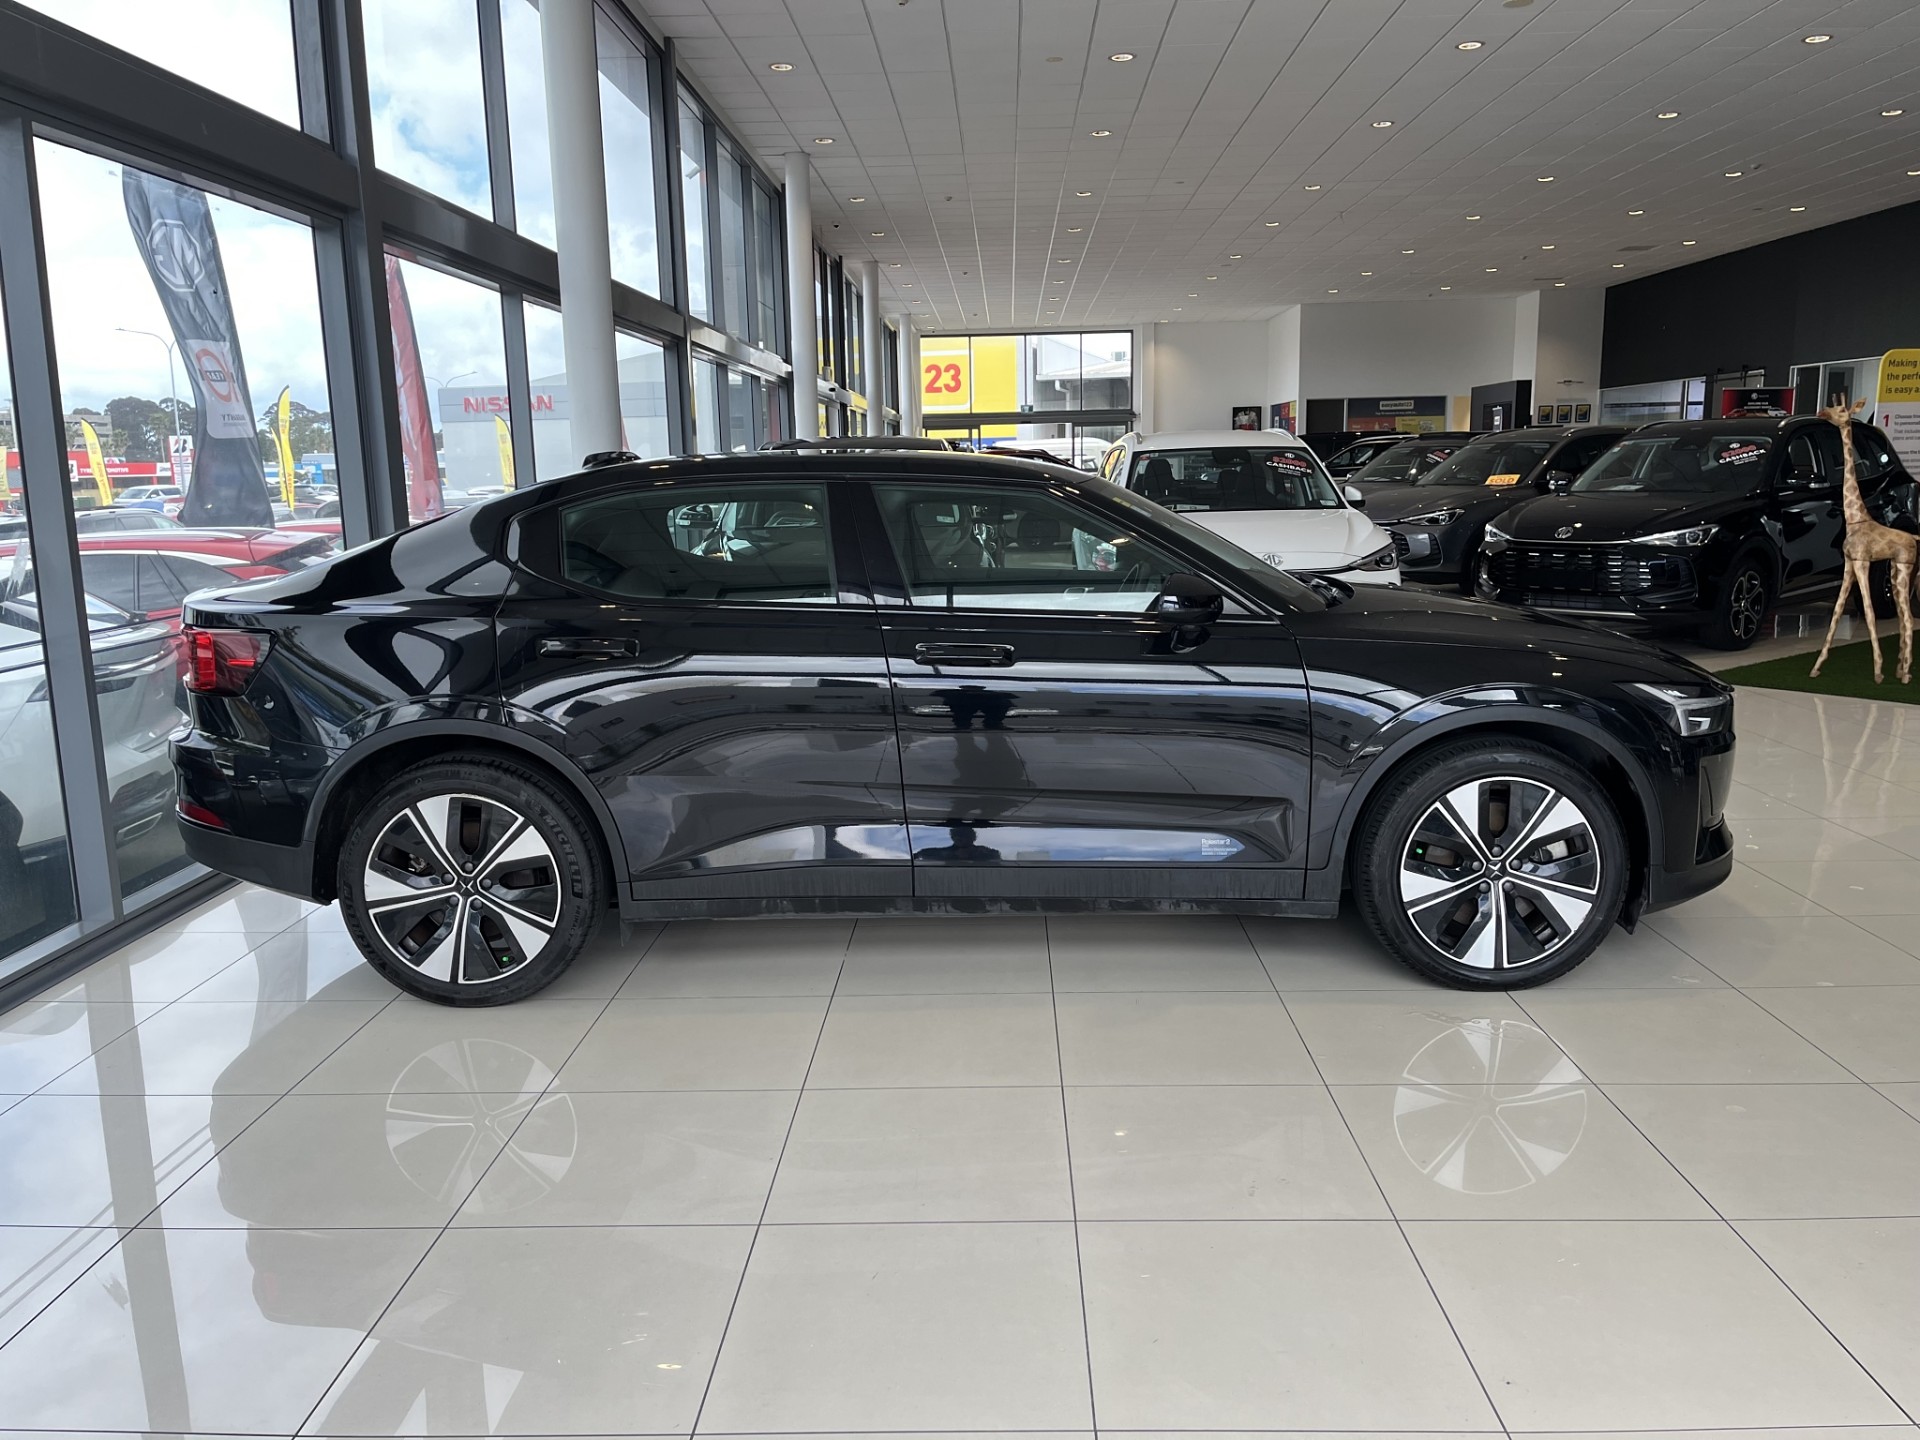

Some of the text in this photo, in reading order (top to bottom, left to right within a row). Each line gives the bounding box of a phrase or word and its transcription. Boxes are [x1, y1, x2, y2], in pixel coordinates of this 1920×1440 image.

[1888, 359, 1918, 369] Making
[924, 364, 962, 394] 23
[1887, 372, 1900, 381] the
[1885, 385, 1893, 394] is
[1894, 386, 1914, 396] easy
[1883, 414, 1890, 427] 1
[1719, 449, 1766, 463] CASHBACK
[1266, 461, 1313, 474] CASHBACK
[1489, 477, 1515, 485] SOLD
[543, 813, 583, 894] MICHELIN
